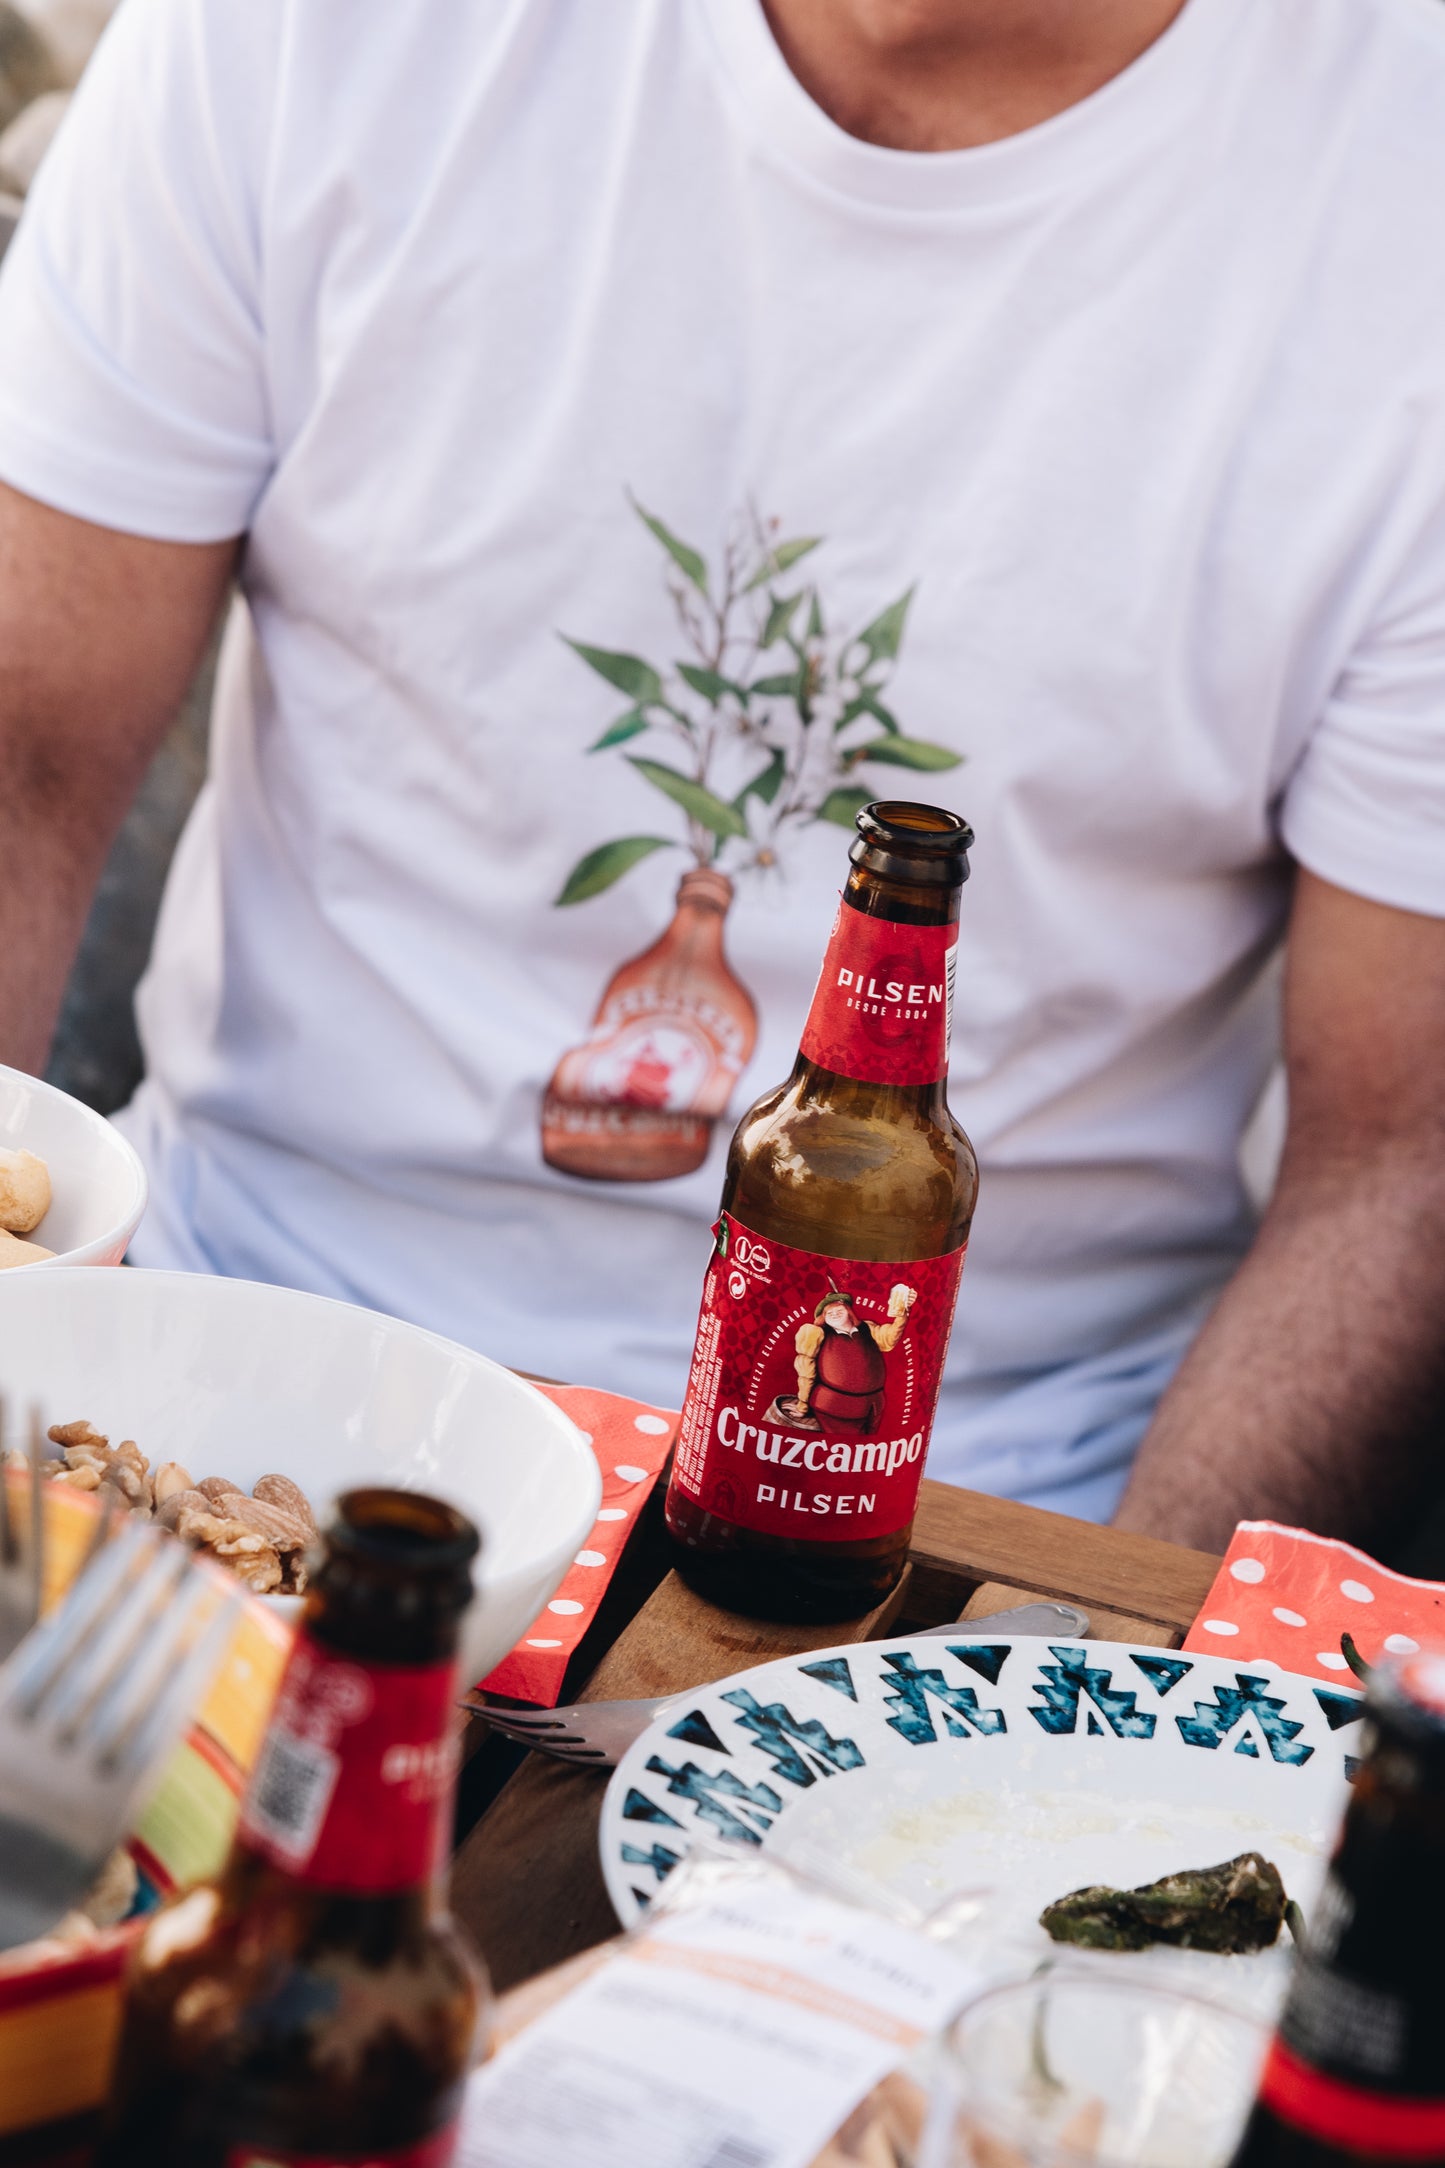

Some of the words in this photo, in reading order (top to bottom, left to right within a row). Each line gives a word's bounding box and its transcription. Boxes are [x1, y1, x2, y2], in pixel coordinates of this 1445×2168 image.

[837, 967, 943, 1004] PILSEN
[846, 997, 886, 1016] DESDE
[896, 1008, 928, 1020] 1904
[746, 1362, 765, 1411] CERVEZA
[761, 1306, 807, 1357] ELABORADA
[855, 1296, 876, 1309] CON
[902, 1337, 913, 1356] SOL
[717, 1406, 922, 1477] Cruzcampo
[757, 1484, 876, 1514] PILSEN
